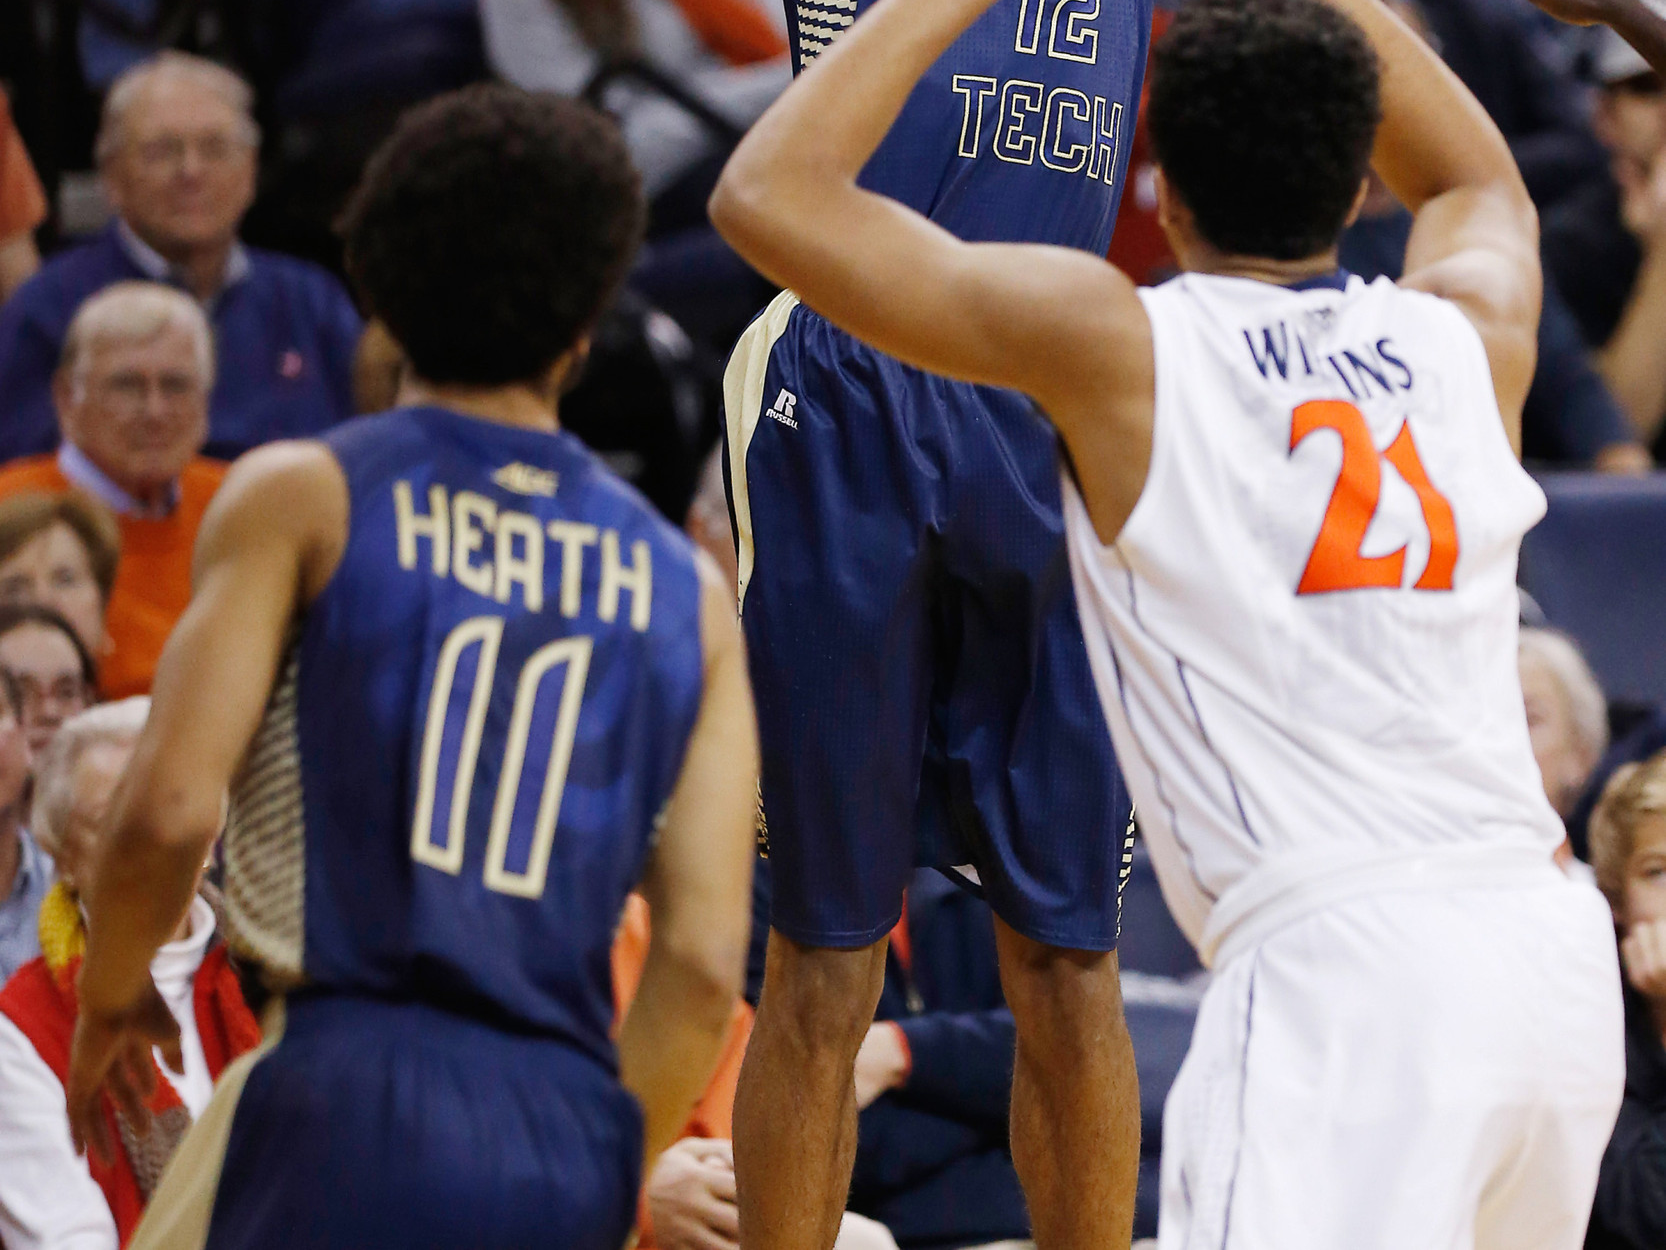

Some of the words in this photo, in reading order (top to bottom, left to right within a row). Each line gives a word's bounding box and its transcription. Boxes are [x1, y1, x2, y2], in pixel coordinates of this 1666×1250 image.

[952, 74, 1123, 185] TECH
[1242, 320, 1413, 400] WIINS
[393, 480, 652, 632] HEATH
[1286, 398, 1461, 596] 21
[410, 615, 593, 901] 11
